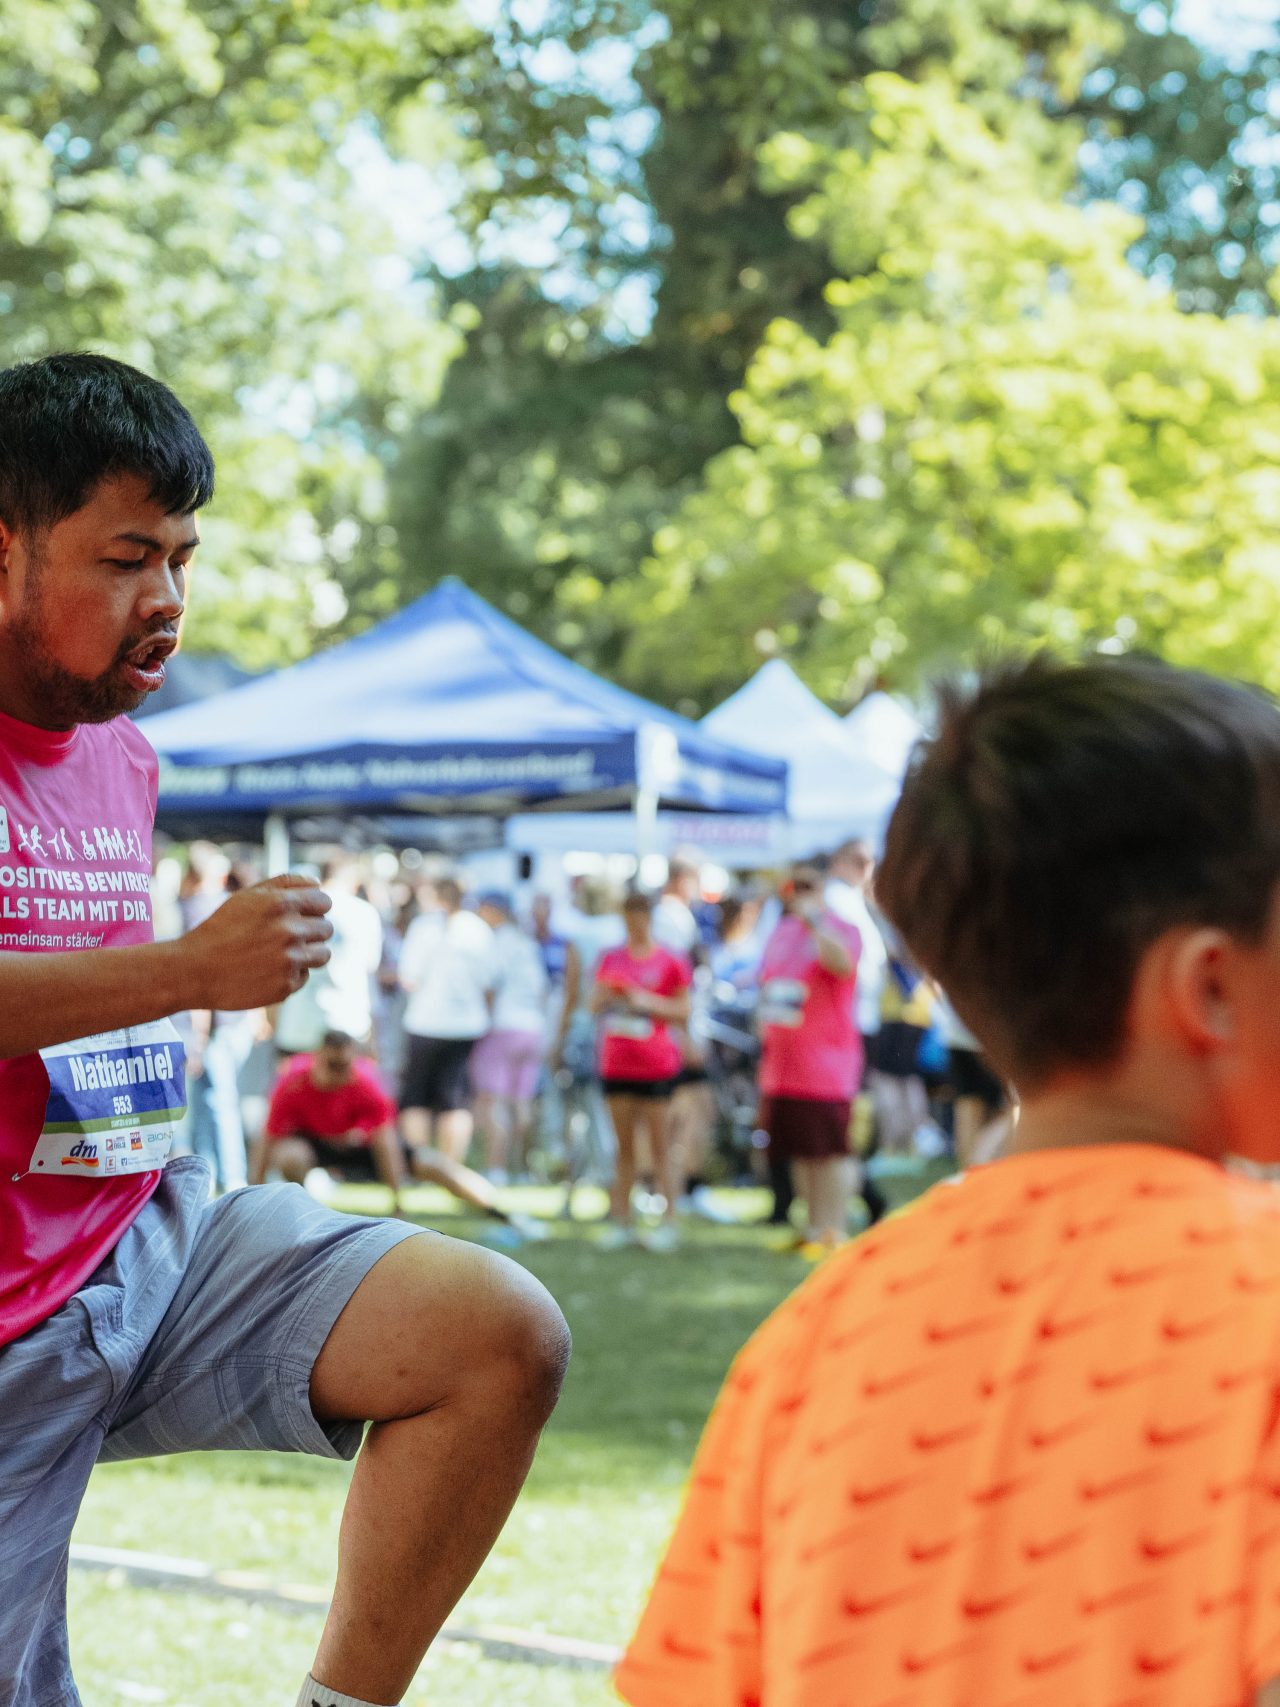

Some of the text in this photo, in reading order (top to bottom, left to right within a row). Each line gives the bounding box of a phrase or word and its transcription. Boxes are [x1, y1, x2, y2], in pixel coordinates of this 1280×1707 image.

[34, 898, 85, 921] TEAM
[89, 900, 118, 921] MIT
[122, 900, 150, 921] DIR.
[66, 932, 105, 948] stärker!
[68, 1045, 174, 1092] Nathaniel
[113, 1095, 133, 1115] 553
[70, 1139, 97, 1158] dm
